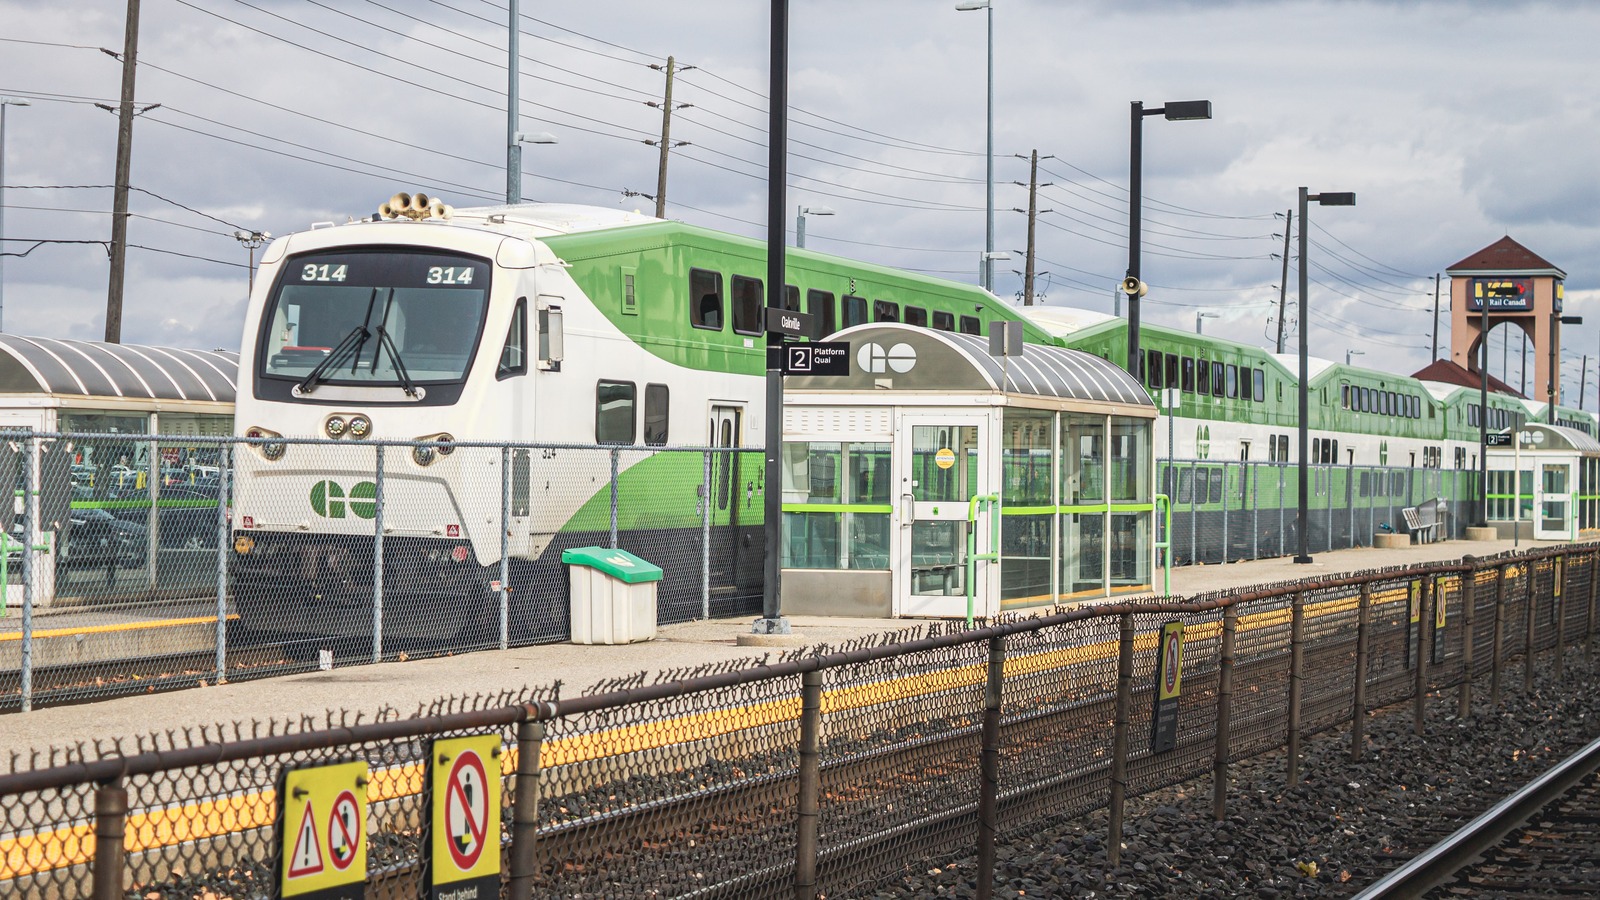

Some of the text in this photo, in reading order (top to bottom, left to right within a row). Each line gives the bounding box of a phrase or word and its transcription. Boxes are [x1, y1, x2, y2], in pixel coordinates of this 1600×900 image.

[301, 263, 347, 282] 314
[426, 266, 473, 285] 314
[1489, 298, 1502, 306] Rail
[781, 315, 801, 331] Oakville
[794, 350, 806, 367] 2
[814, 348, 845, 356] Platform
[814, 356, 831, 364] Quai
[857, 342, 917, 374] GO
[542, 447, 556, 460] 314
[310, 479, 377, 520] GO
[438, 885, 478, 900] Stand behind
